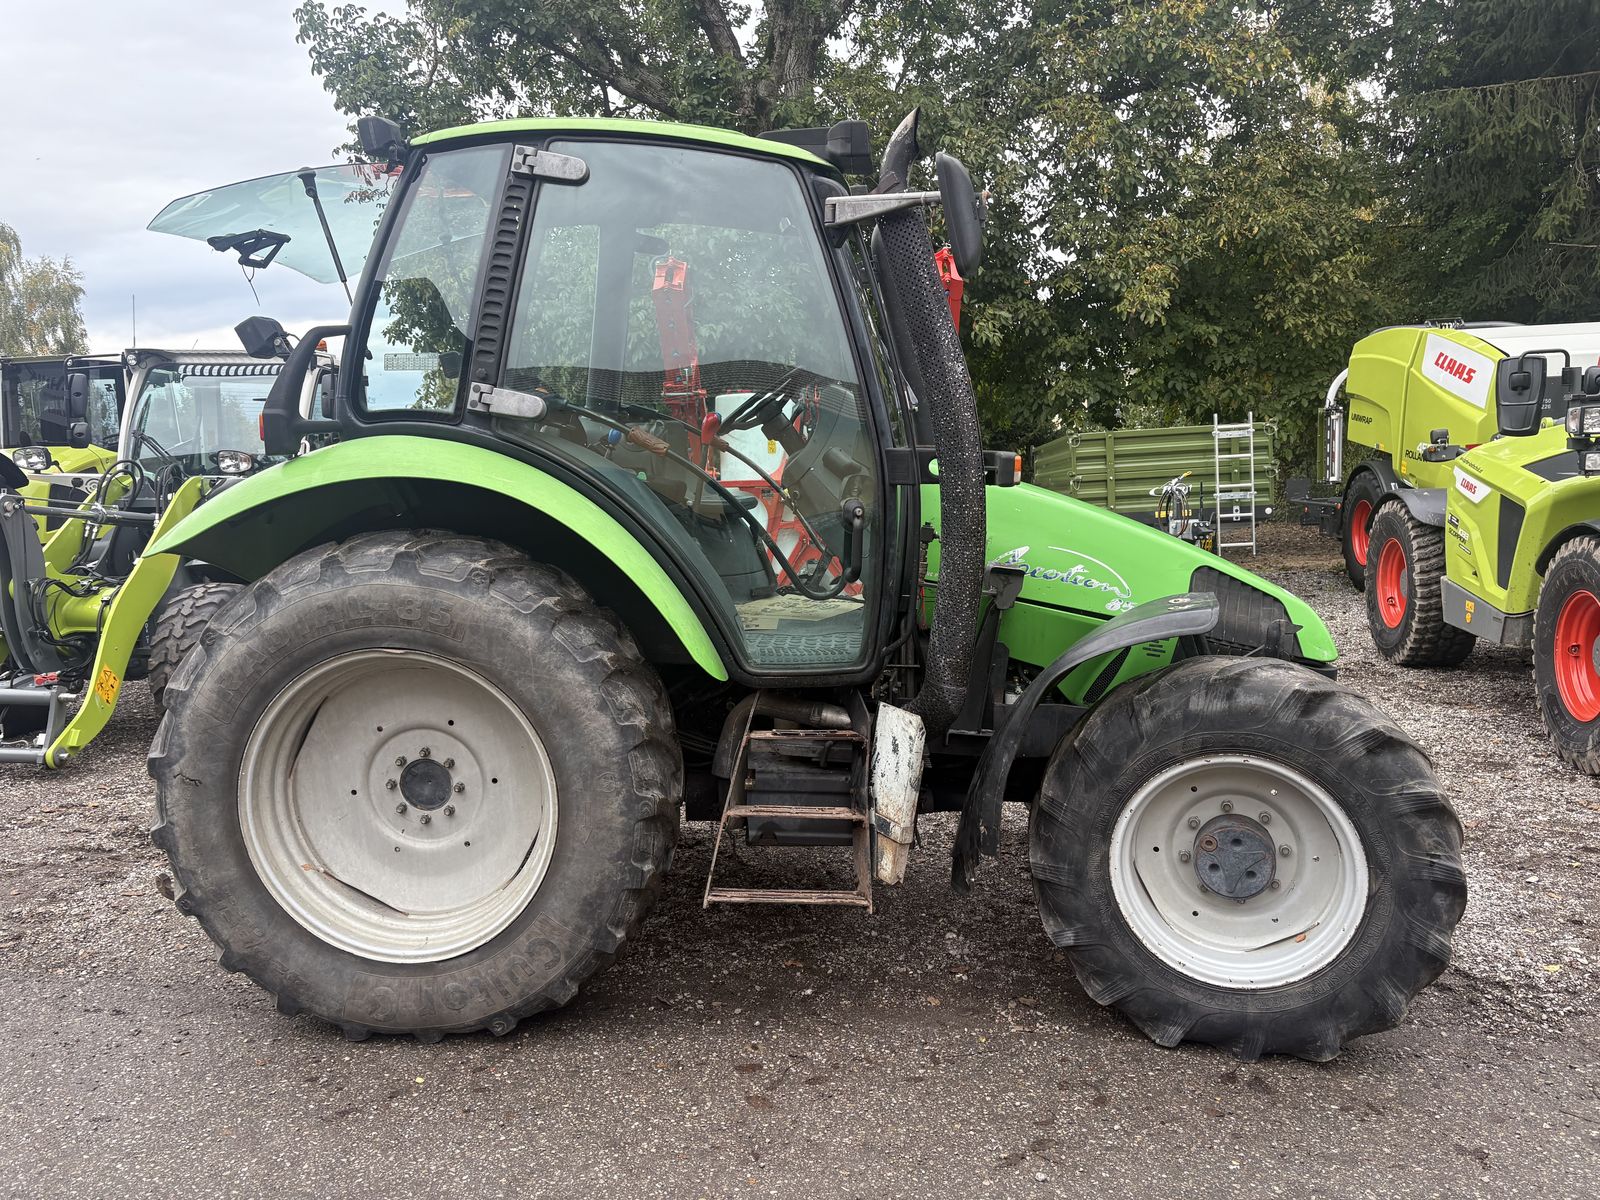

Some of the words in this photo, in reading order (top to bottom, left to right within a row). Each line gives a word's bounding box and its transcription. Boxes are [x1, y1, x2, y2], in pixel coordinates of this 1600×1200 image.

[1434, 352, 1477, 384] CLAAS
[1351, 412, 1373, 425] UNIWRAP
[1460, 477, 1478, 495] CLAAS
